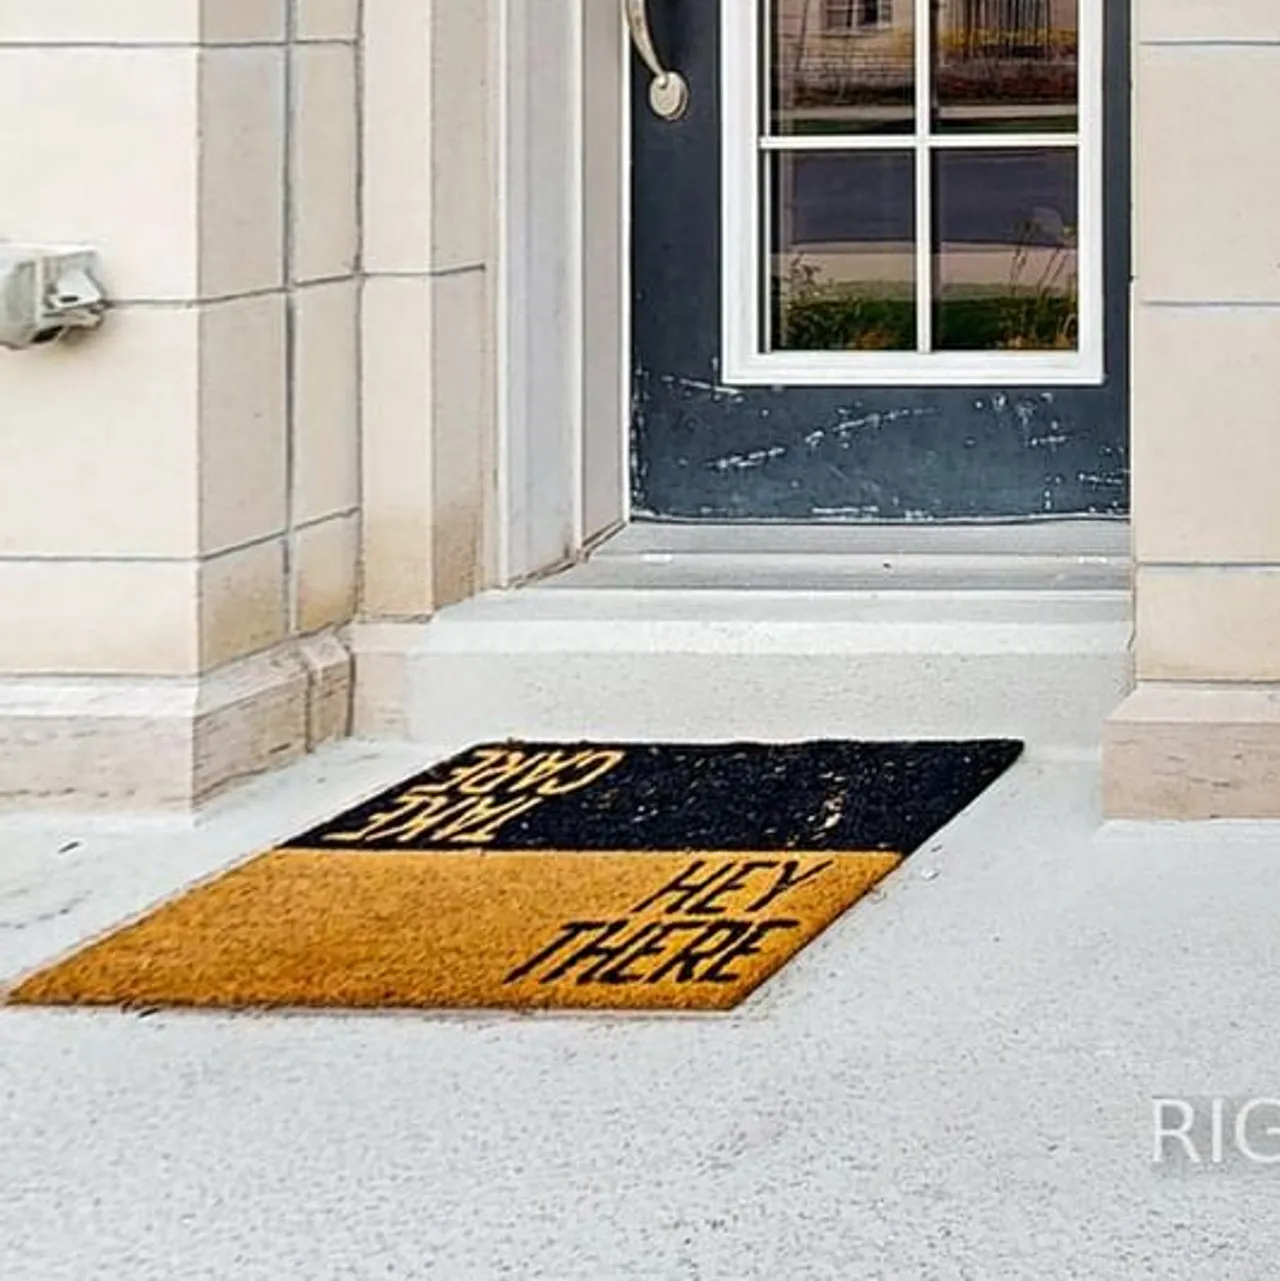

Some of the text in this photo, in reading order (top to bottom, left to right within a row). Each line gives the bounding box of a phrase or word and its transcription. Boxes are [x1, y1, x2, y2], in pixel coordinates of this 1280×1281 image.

[408, 748, 626, 795] CARE
[322, 796, 544, 842] TAKE
[630, 859, 834, 914] HEY
[502, 918, 800, 985] THERE
